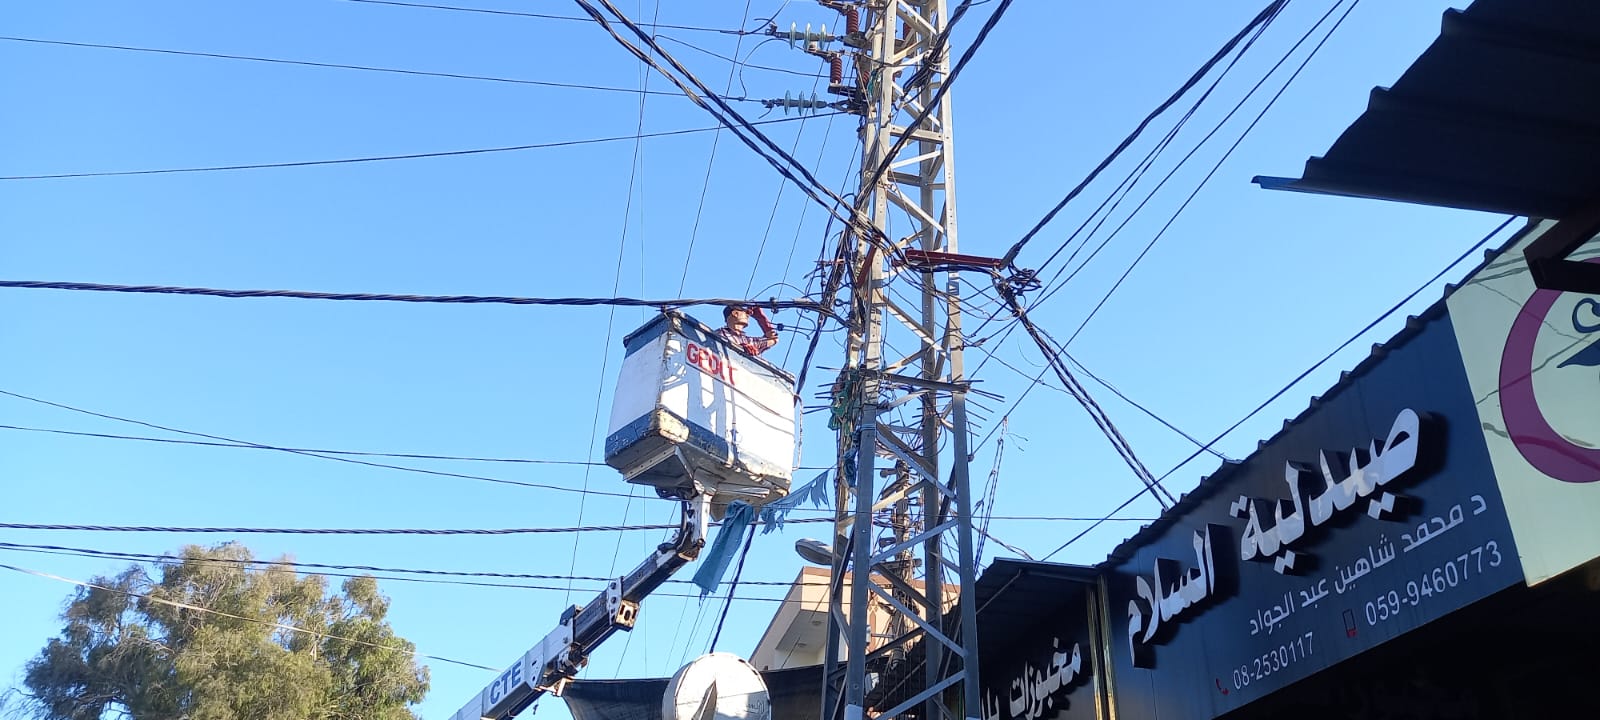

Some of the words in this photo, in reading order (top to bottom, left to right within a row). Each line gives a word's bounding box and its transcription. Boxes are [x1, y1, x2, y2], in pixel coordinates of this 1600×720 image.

[1230, 408, 1420, 575] صيدلية
[1401, 504, 1464, 553] محمد
[1334, 533, 1396, 594] شاهين
[1365, 540, 1502, 626] 059-9460773
[1128, 523, 1215, 668] السلام
[1249, 592, 1295, 635] الجواد
[1300, 578, 1329, 609] عبد
[490, 660, 522, 704] CTE
[1010, 637, 1081, 720] مخبوزات
[1232, 632, 1314, 690] 08-2530117
